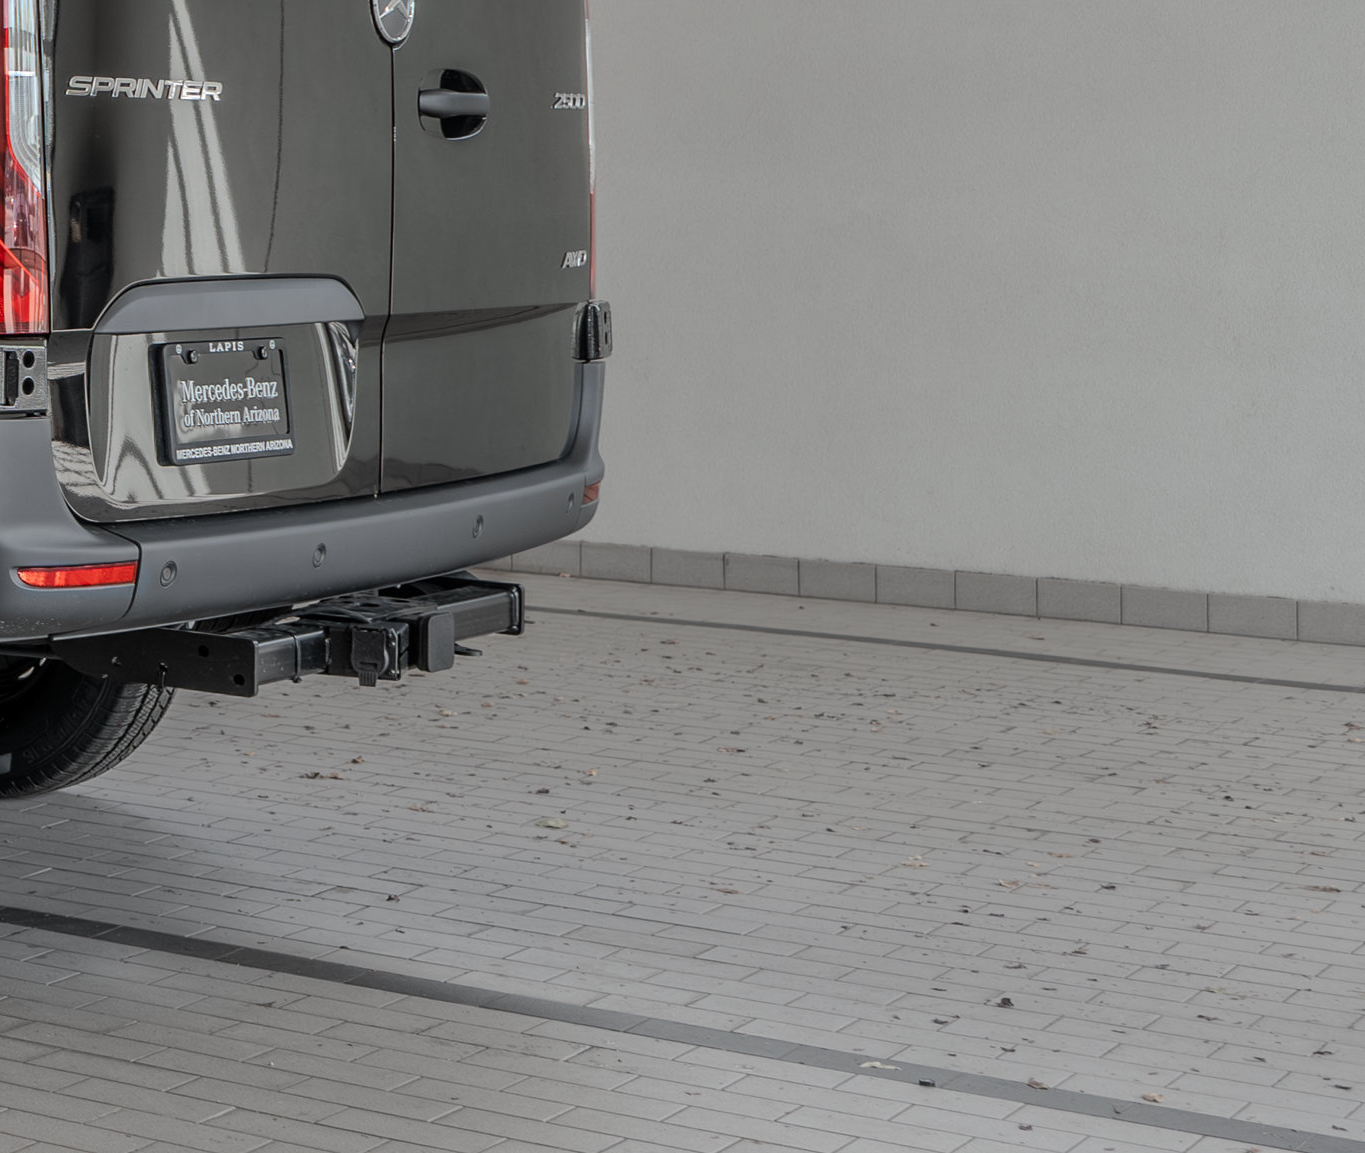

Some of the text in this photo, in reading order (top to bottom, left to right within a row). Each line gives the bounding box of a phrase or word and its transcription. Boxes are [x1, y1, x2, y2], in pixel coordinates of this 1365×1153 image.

[65, 75, 224, 101] SPRINTER
[553, 92, 586, 109] 2500
[209, 342, 244, 352] LAPIS
[182, 377, 278, 402] Mercedes-Benz
[184, 405, 280, 427] of Northern Arizona
[176, 439, 294, 460] MERCEDES-BENZ NORTHERN ARIZONA
